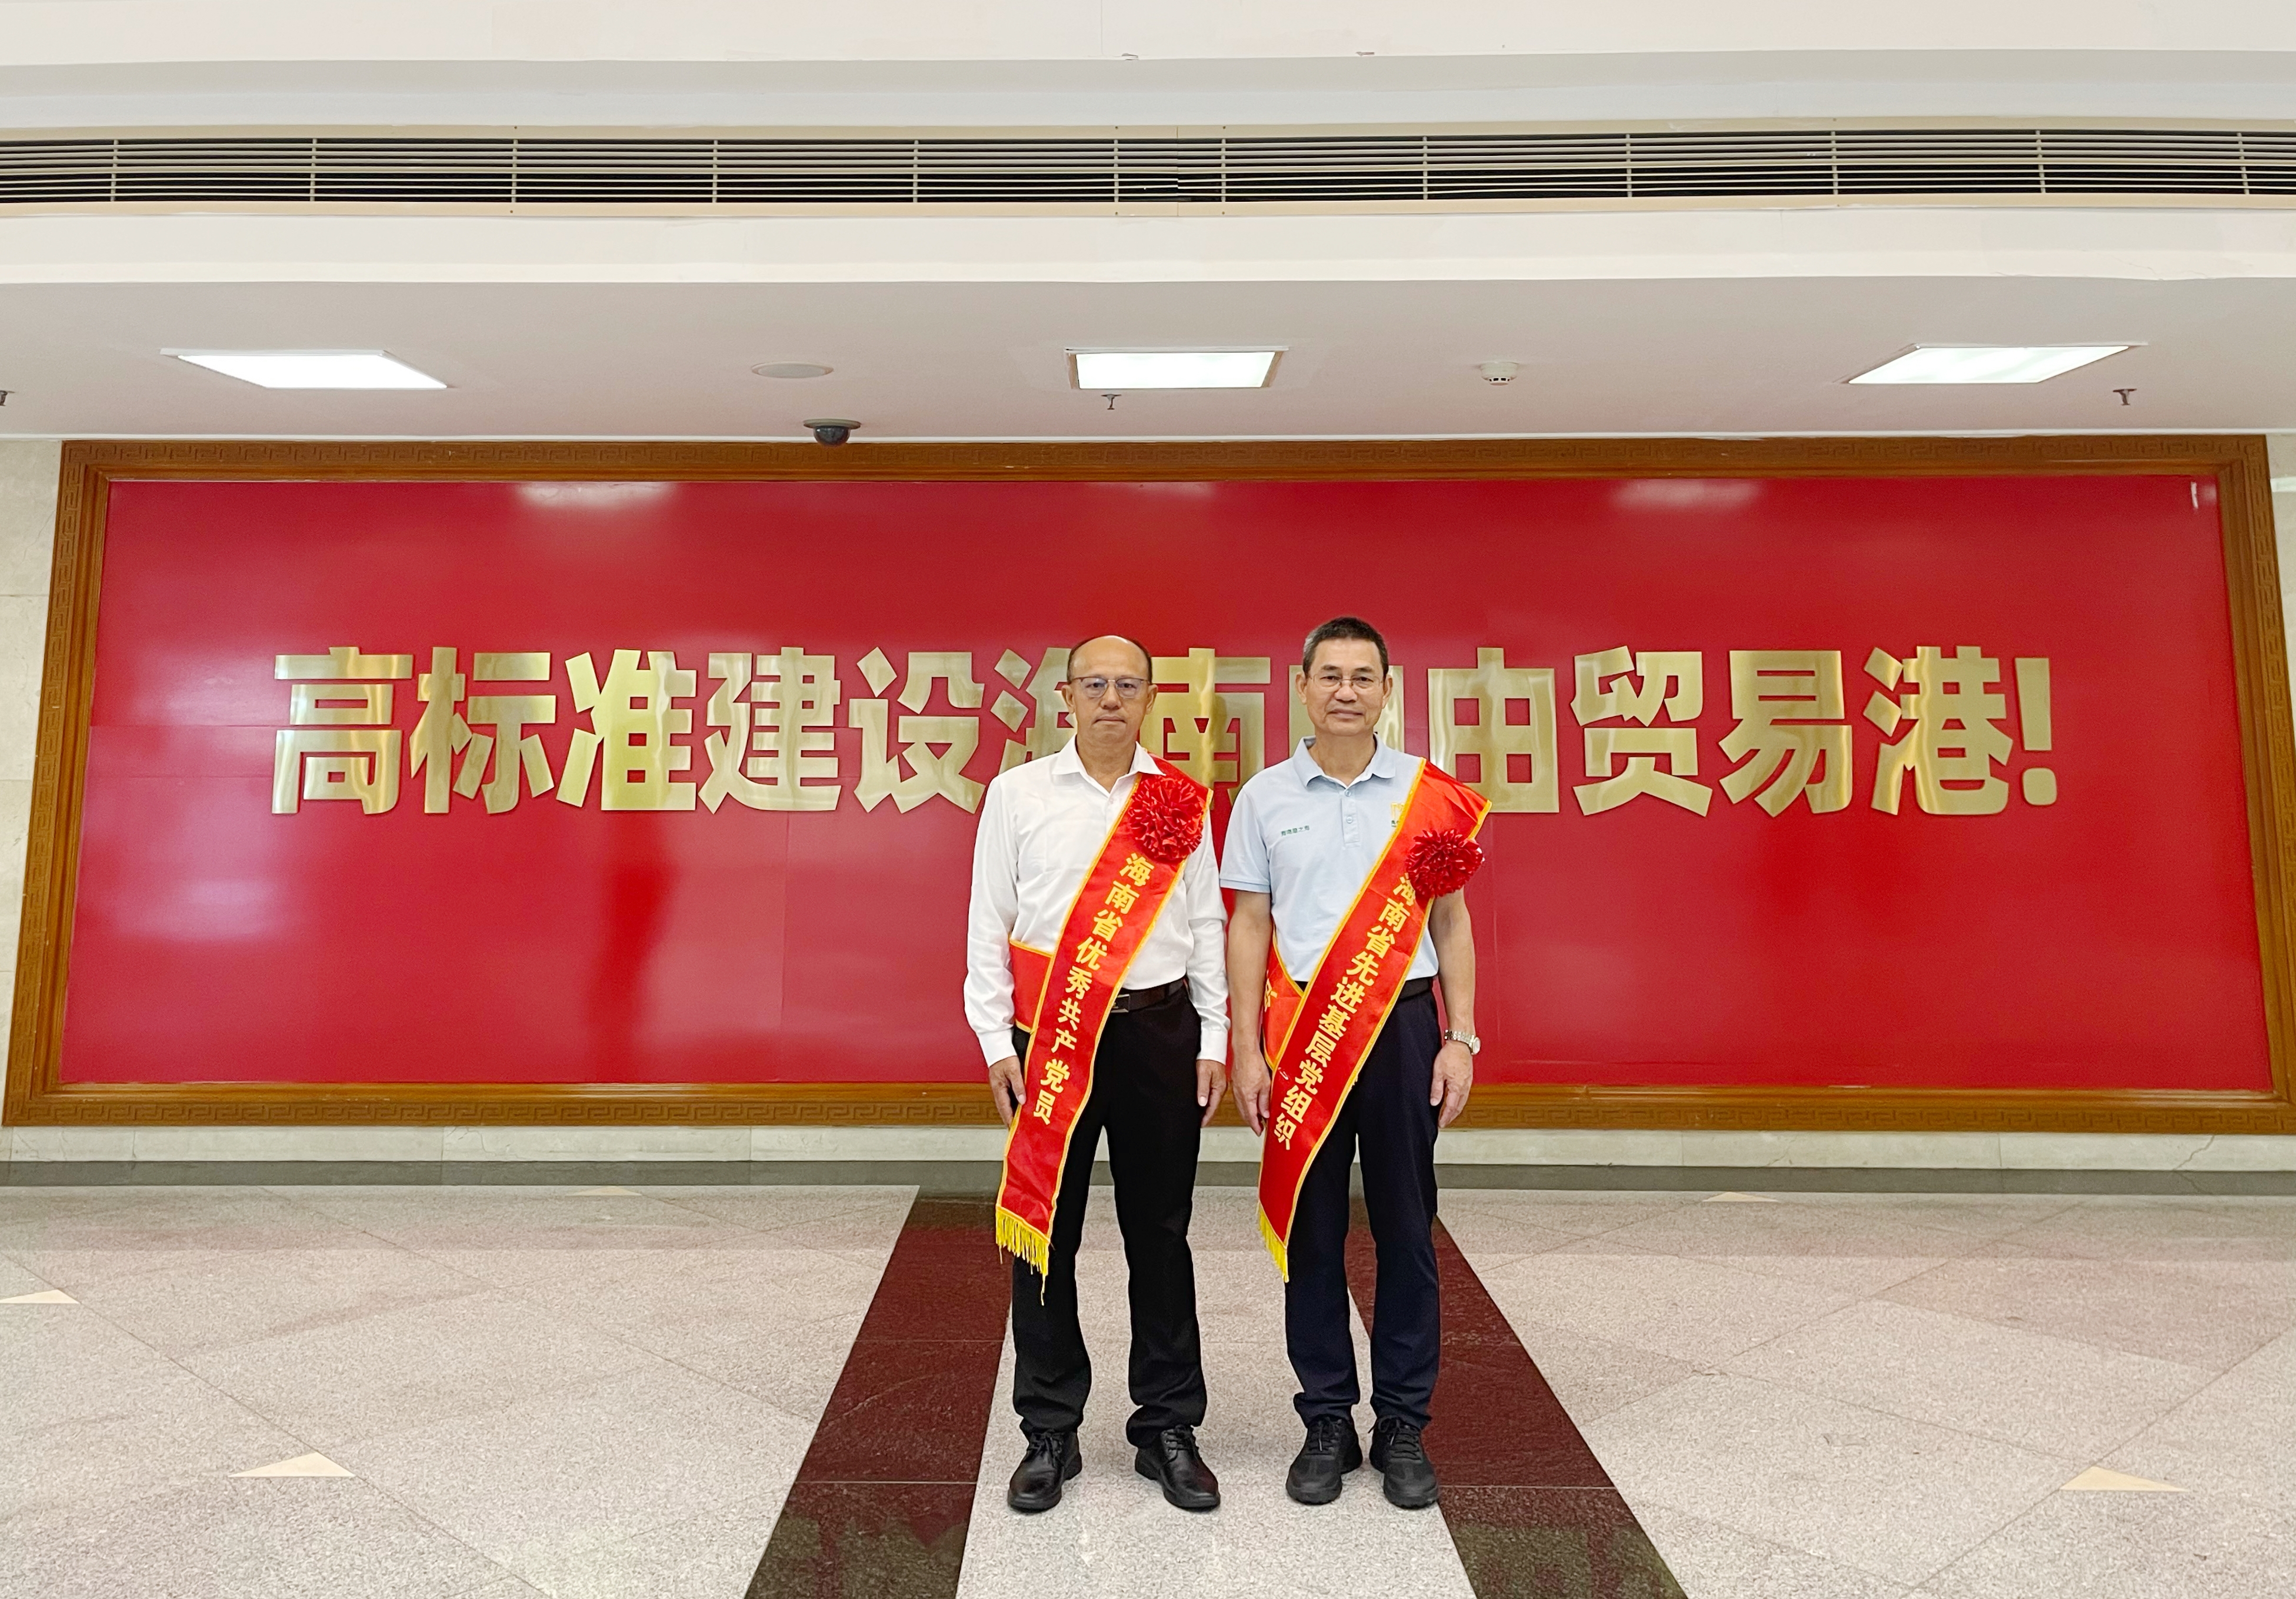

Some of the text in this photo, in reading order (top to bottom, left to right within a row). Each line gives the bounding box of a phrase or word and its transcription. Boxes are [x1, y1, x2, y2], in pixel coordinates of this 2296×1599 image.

[271, 645, 2058, 818] 高标准建设南由贸易港!
[1034, 852, 1154, 1124] 海南省优秀共产党员
